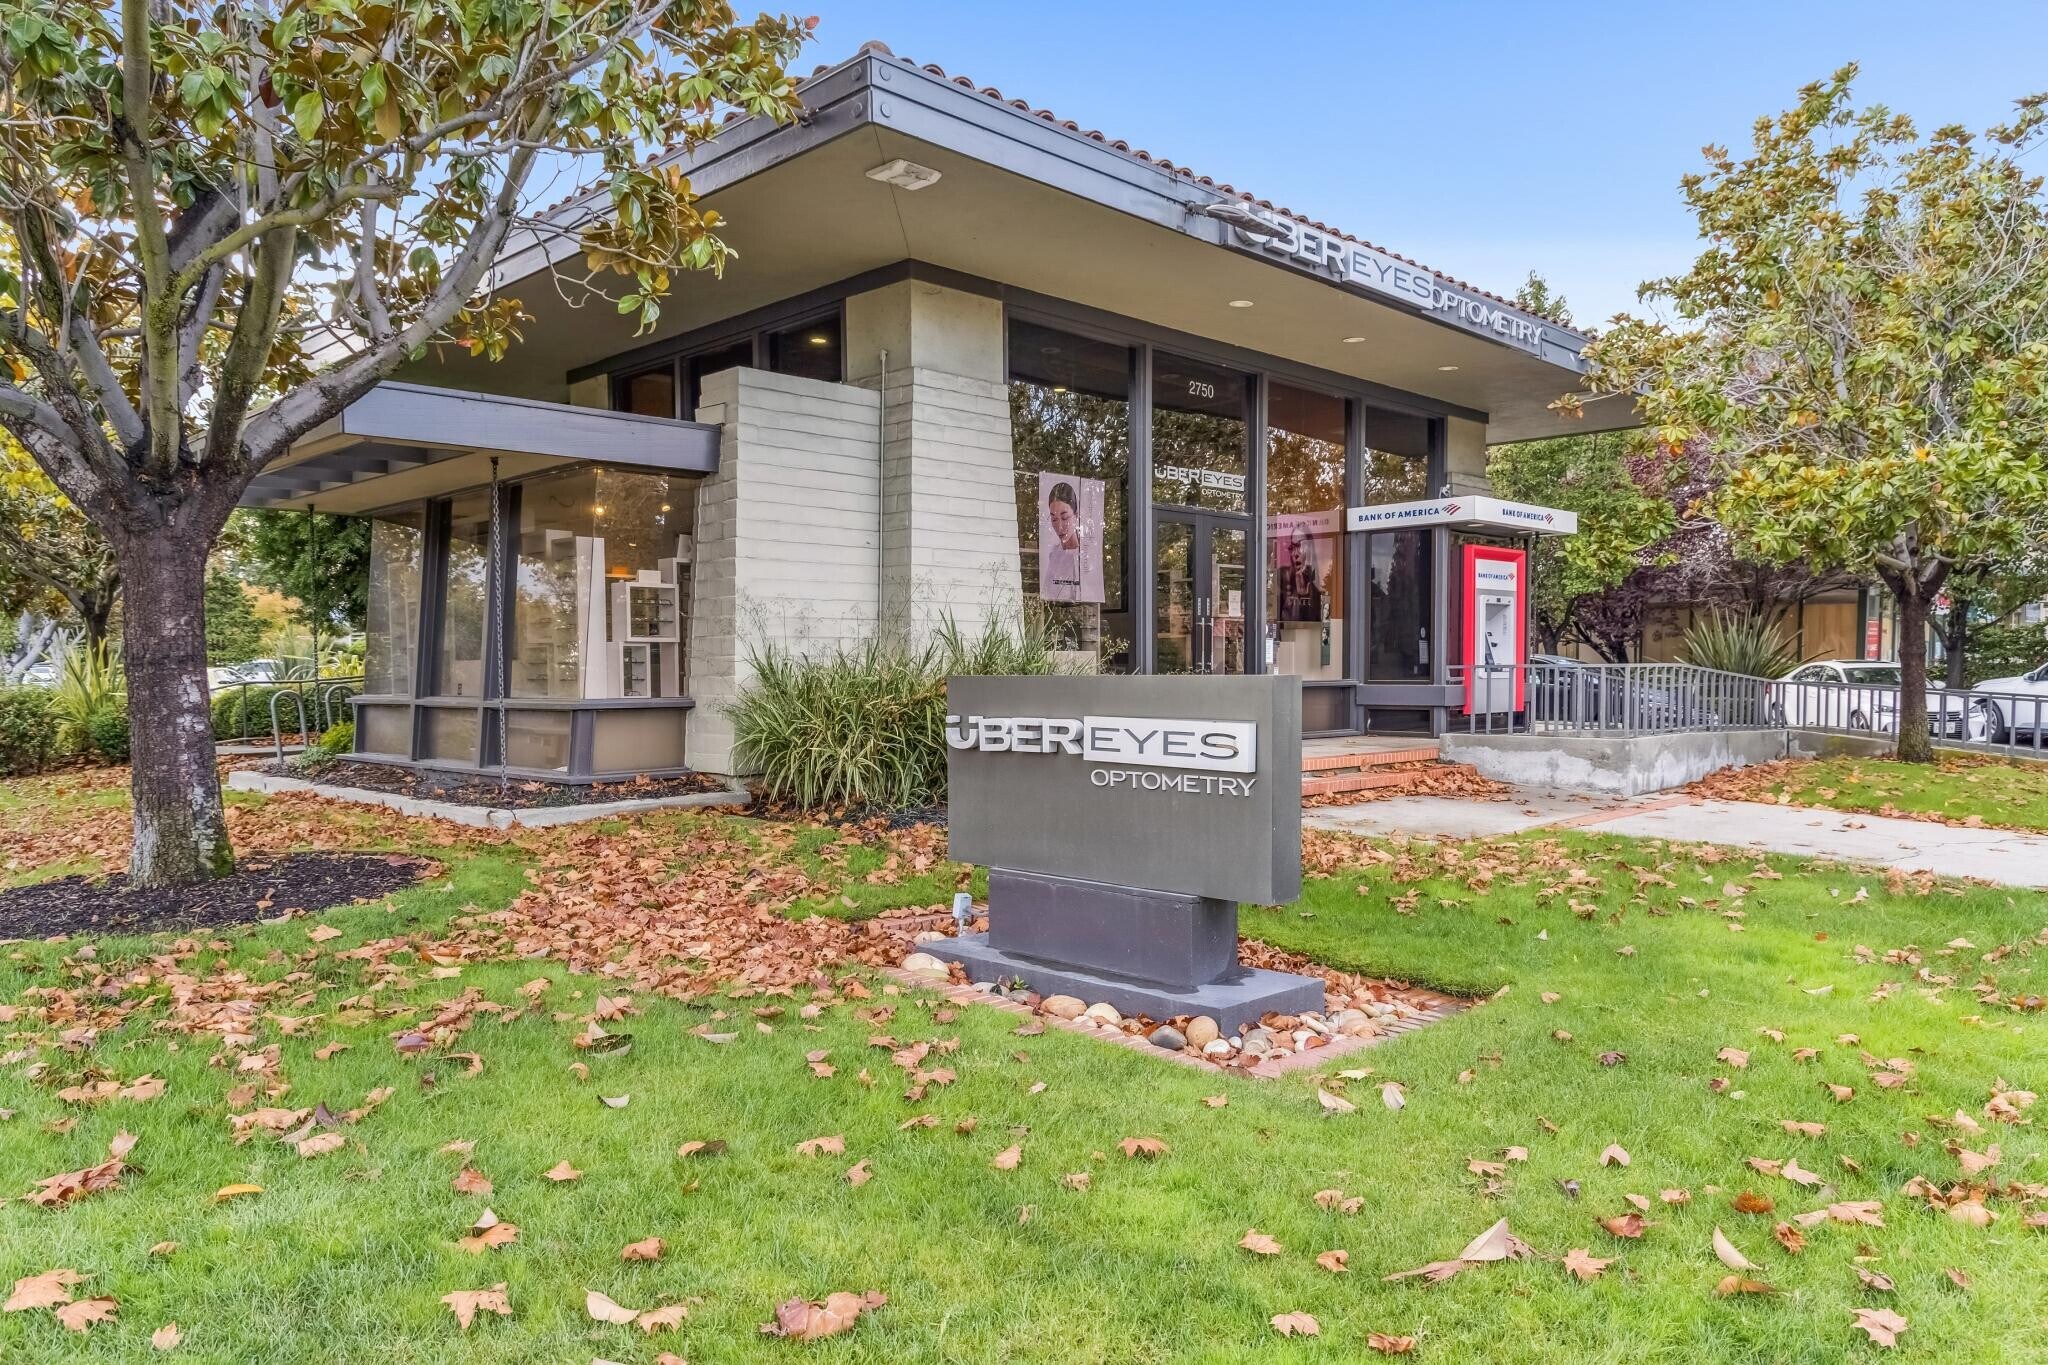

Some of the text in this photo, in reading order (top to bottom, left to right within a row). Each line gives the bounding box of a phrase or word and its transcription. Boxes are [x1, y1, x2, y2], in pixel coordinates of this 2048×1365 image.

[1235, 202, 1431, 299] BER EYES
[1432, 286, 1543, 345] OPTOMETRY
[1189, 380, 1214, 399] 2750
[1203, 473, 1243, 488] EYES
[1201, 488, 1245, 501] OPTOMETRY
[1358, 508, 1440, 522] BANK OF AMERICA
[1502, 508, 1516, 517] BANK
[1523, 511, 1544, 521] AMERICA
[1090, 726, 1240, 760] EYES
[1090, 769, 1257, 797] OPTOMETRY
